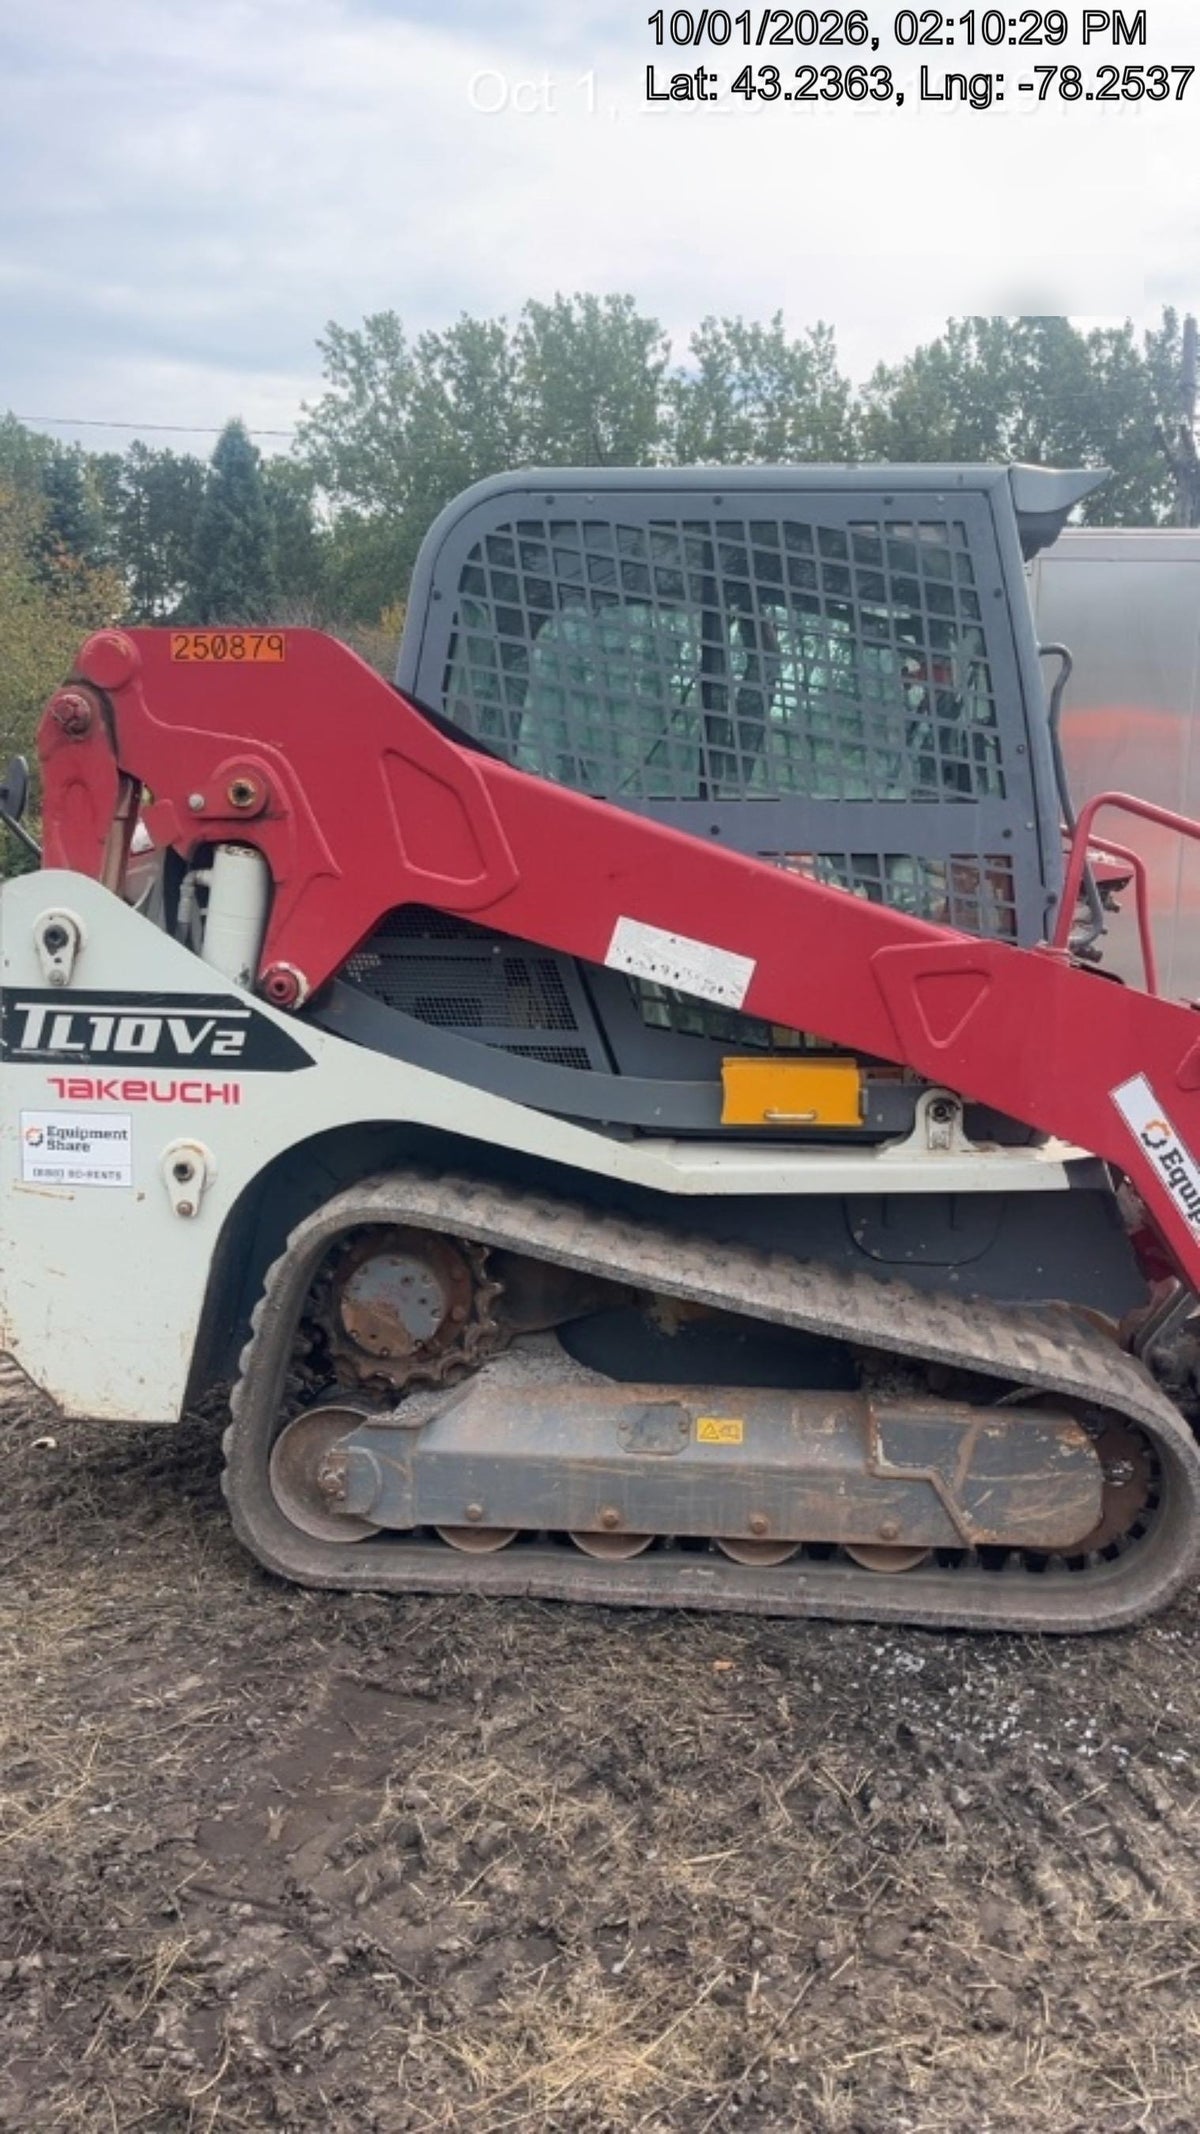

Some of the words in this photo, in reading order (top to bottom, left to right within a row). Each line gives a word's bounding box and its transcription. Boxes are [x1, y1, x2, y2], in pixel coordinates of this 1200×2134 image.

[174, 634, 284, 660] 250879
[46, 1125, 128, 1141] Equipment
[46, 1138, 91, 1153] Share
